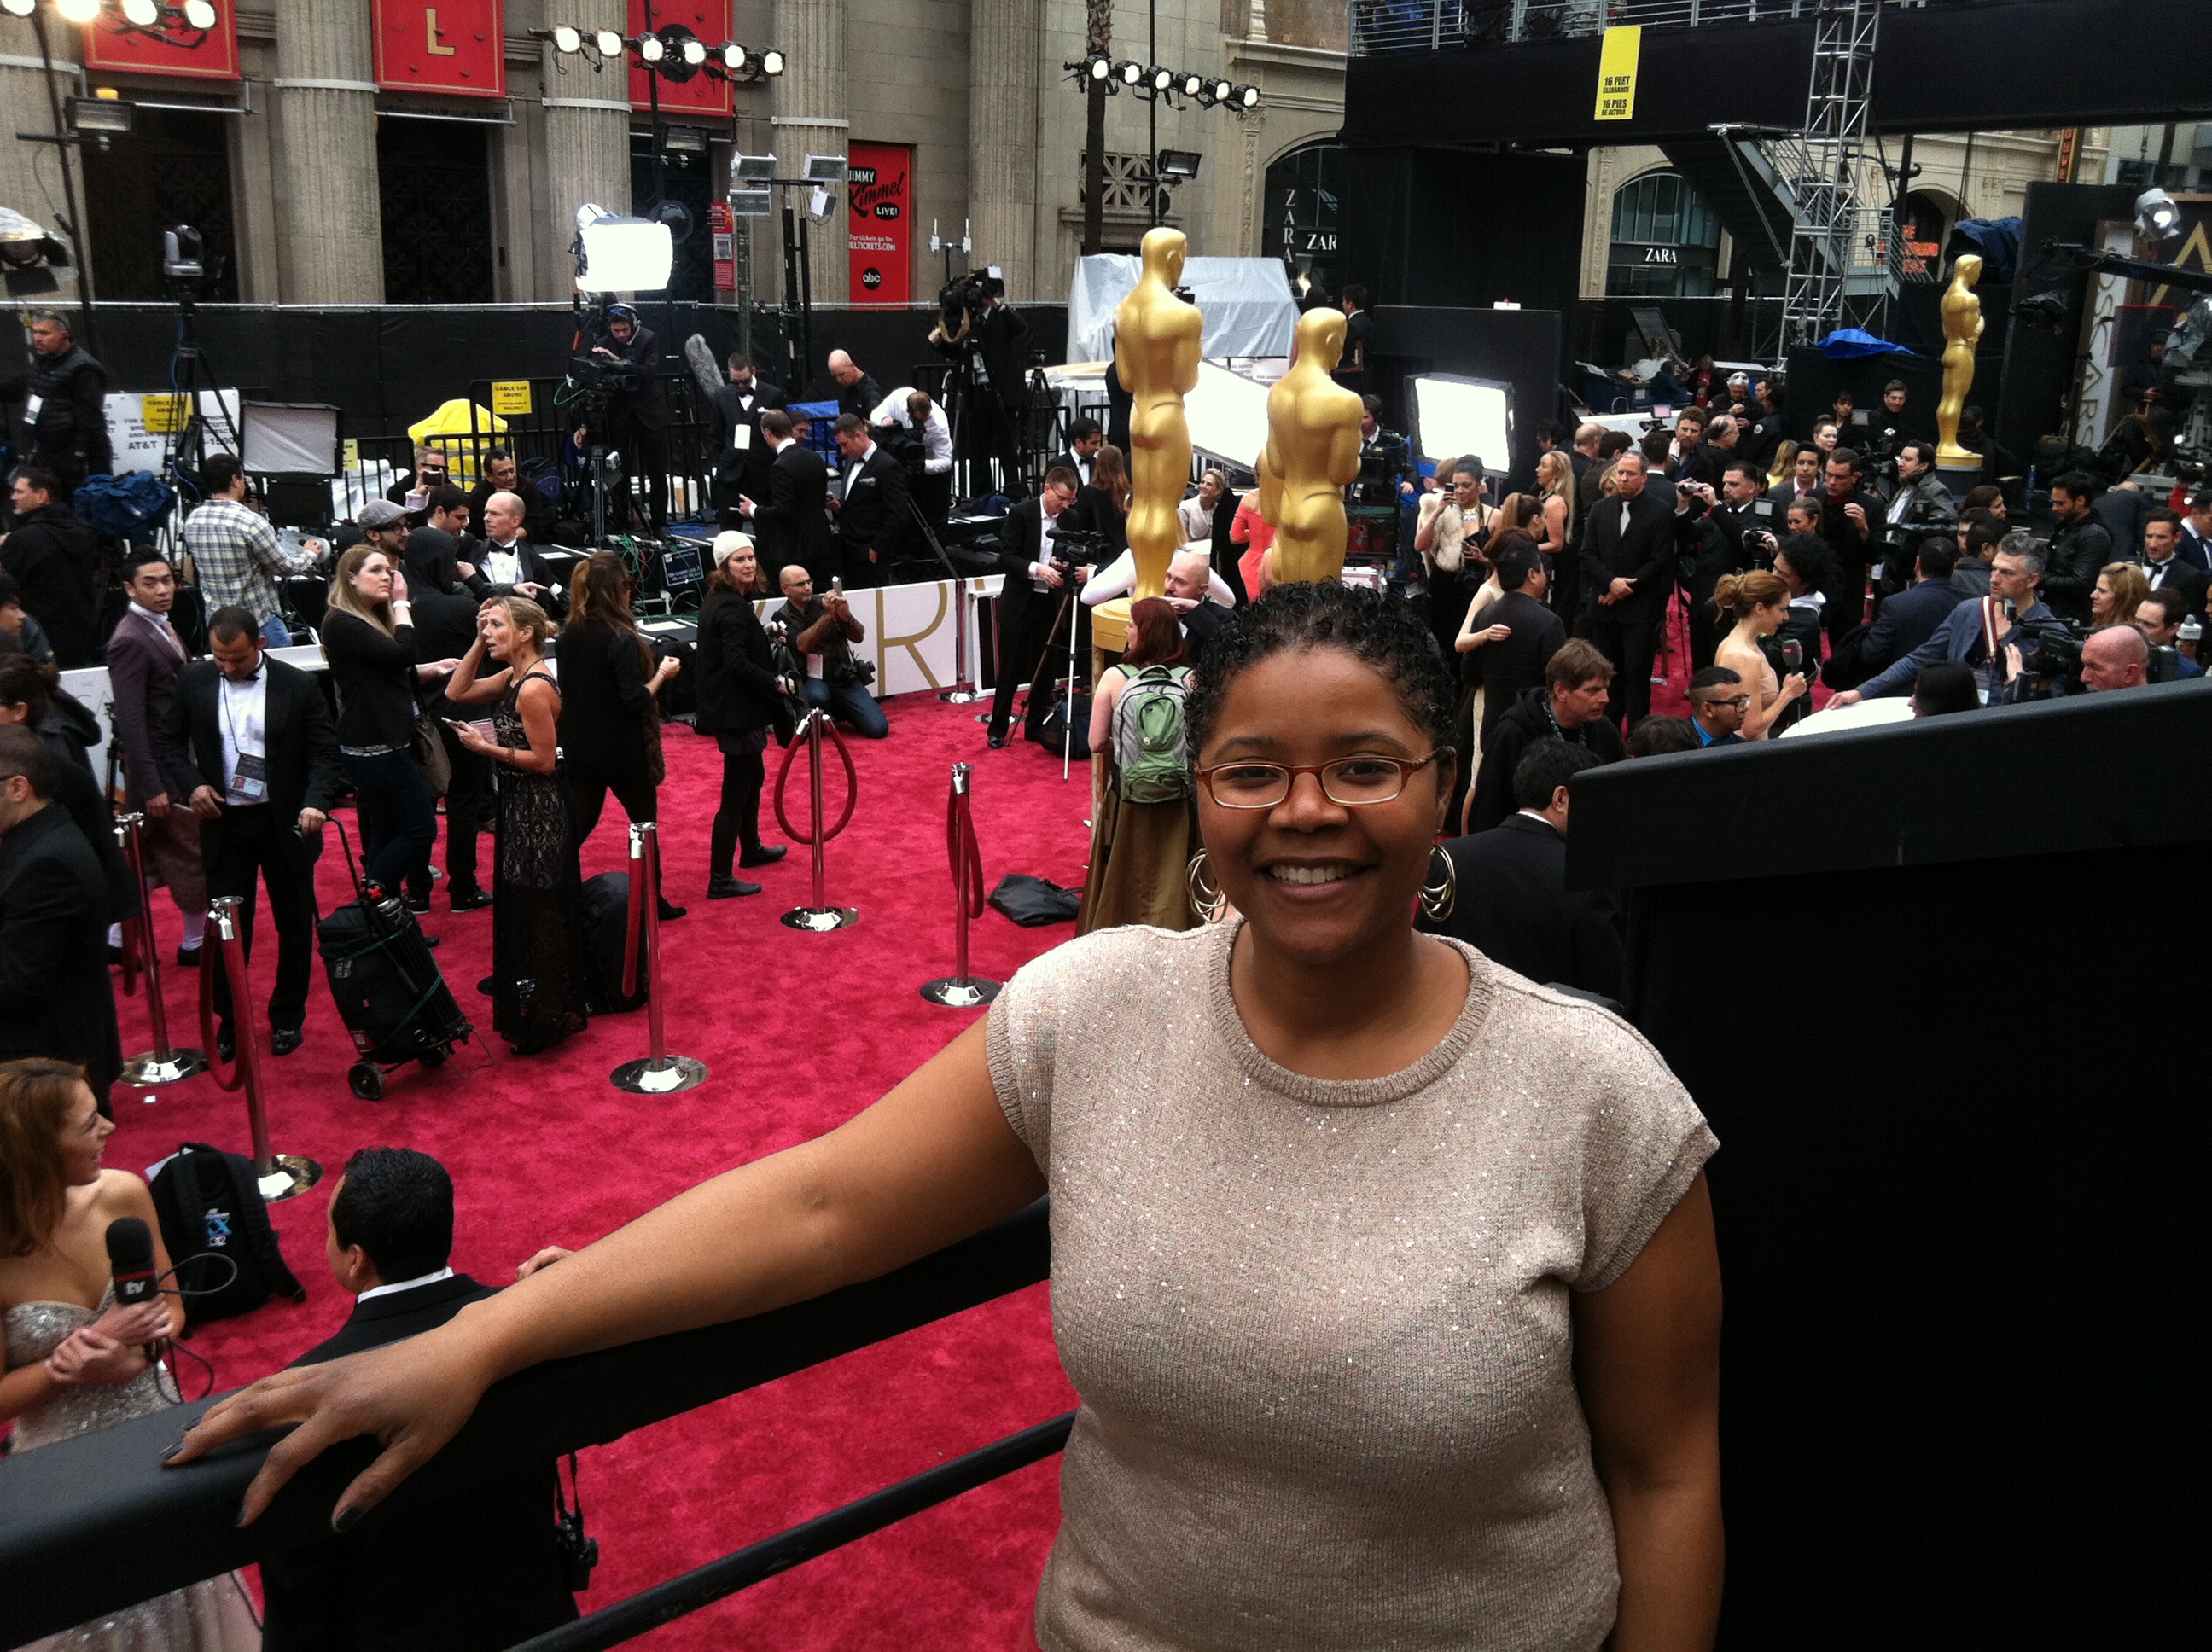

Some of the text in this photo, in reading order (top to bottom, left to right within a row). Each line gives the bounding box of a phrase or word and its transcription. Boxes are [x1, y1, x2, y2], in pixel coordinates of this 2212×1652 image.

[425, 7, 456, 56] L
[1604, 76, 1613, 86] 16
[1602, 99, 1627, 108] 16 PIES
[849, 170, 875, 183] JIMMY
[848, 172, 905, 218] Kimmel
[876, 206, 899, 217] LIVE!
[1283, 189, 1296, 263] ZARA
[1645, 247, 1677, 263] ZARA
[862, 271, 881, 283] abc
[128, 440, 158, 450] AT&T
